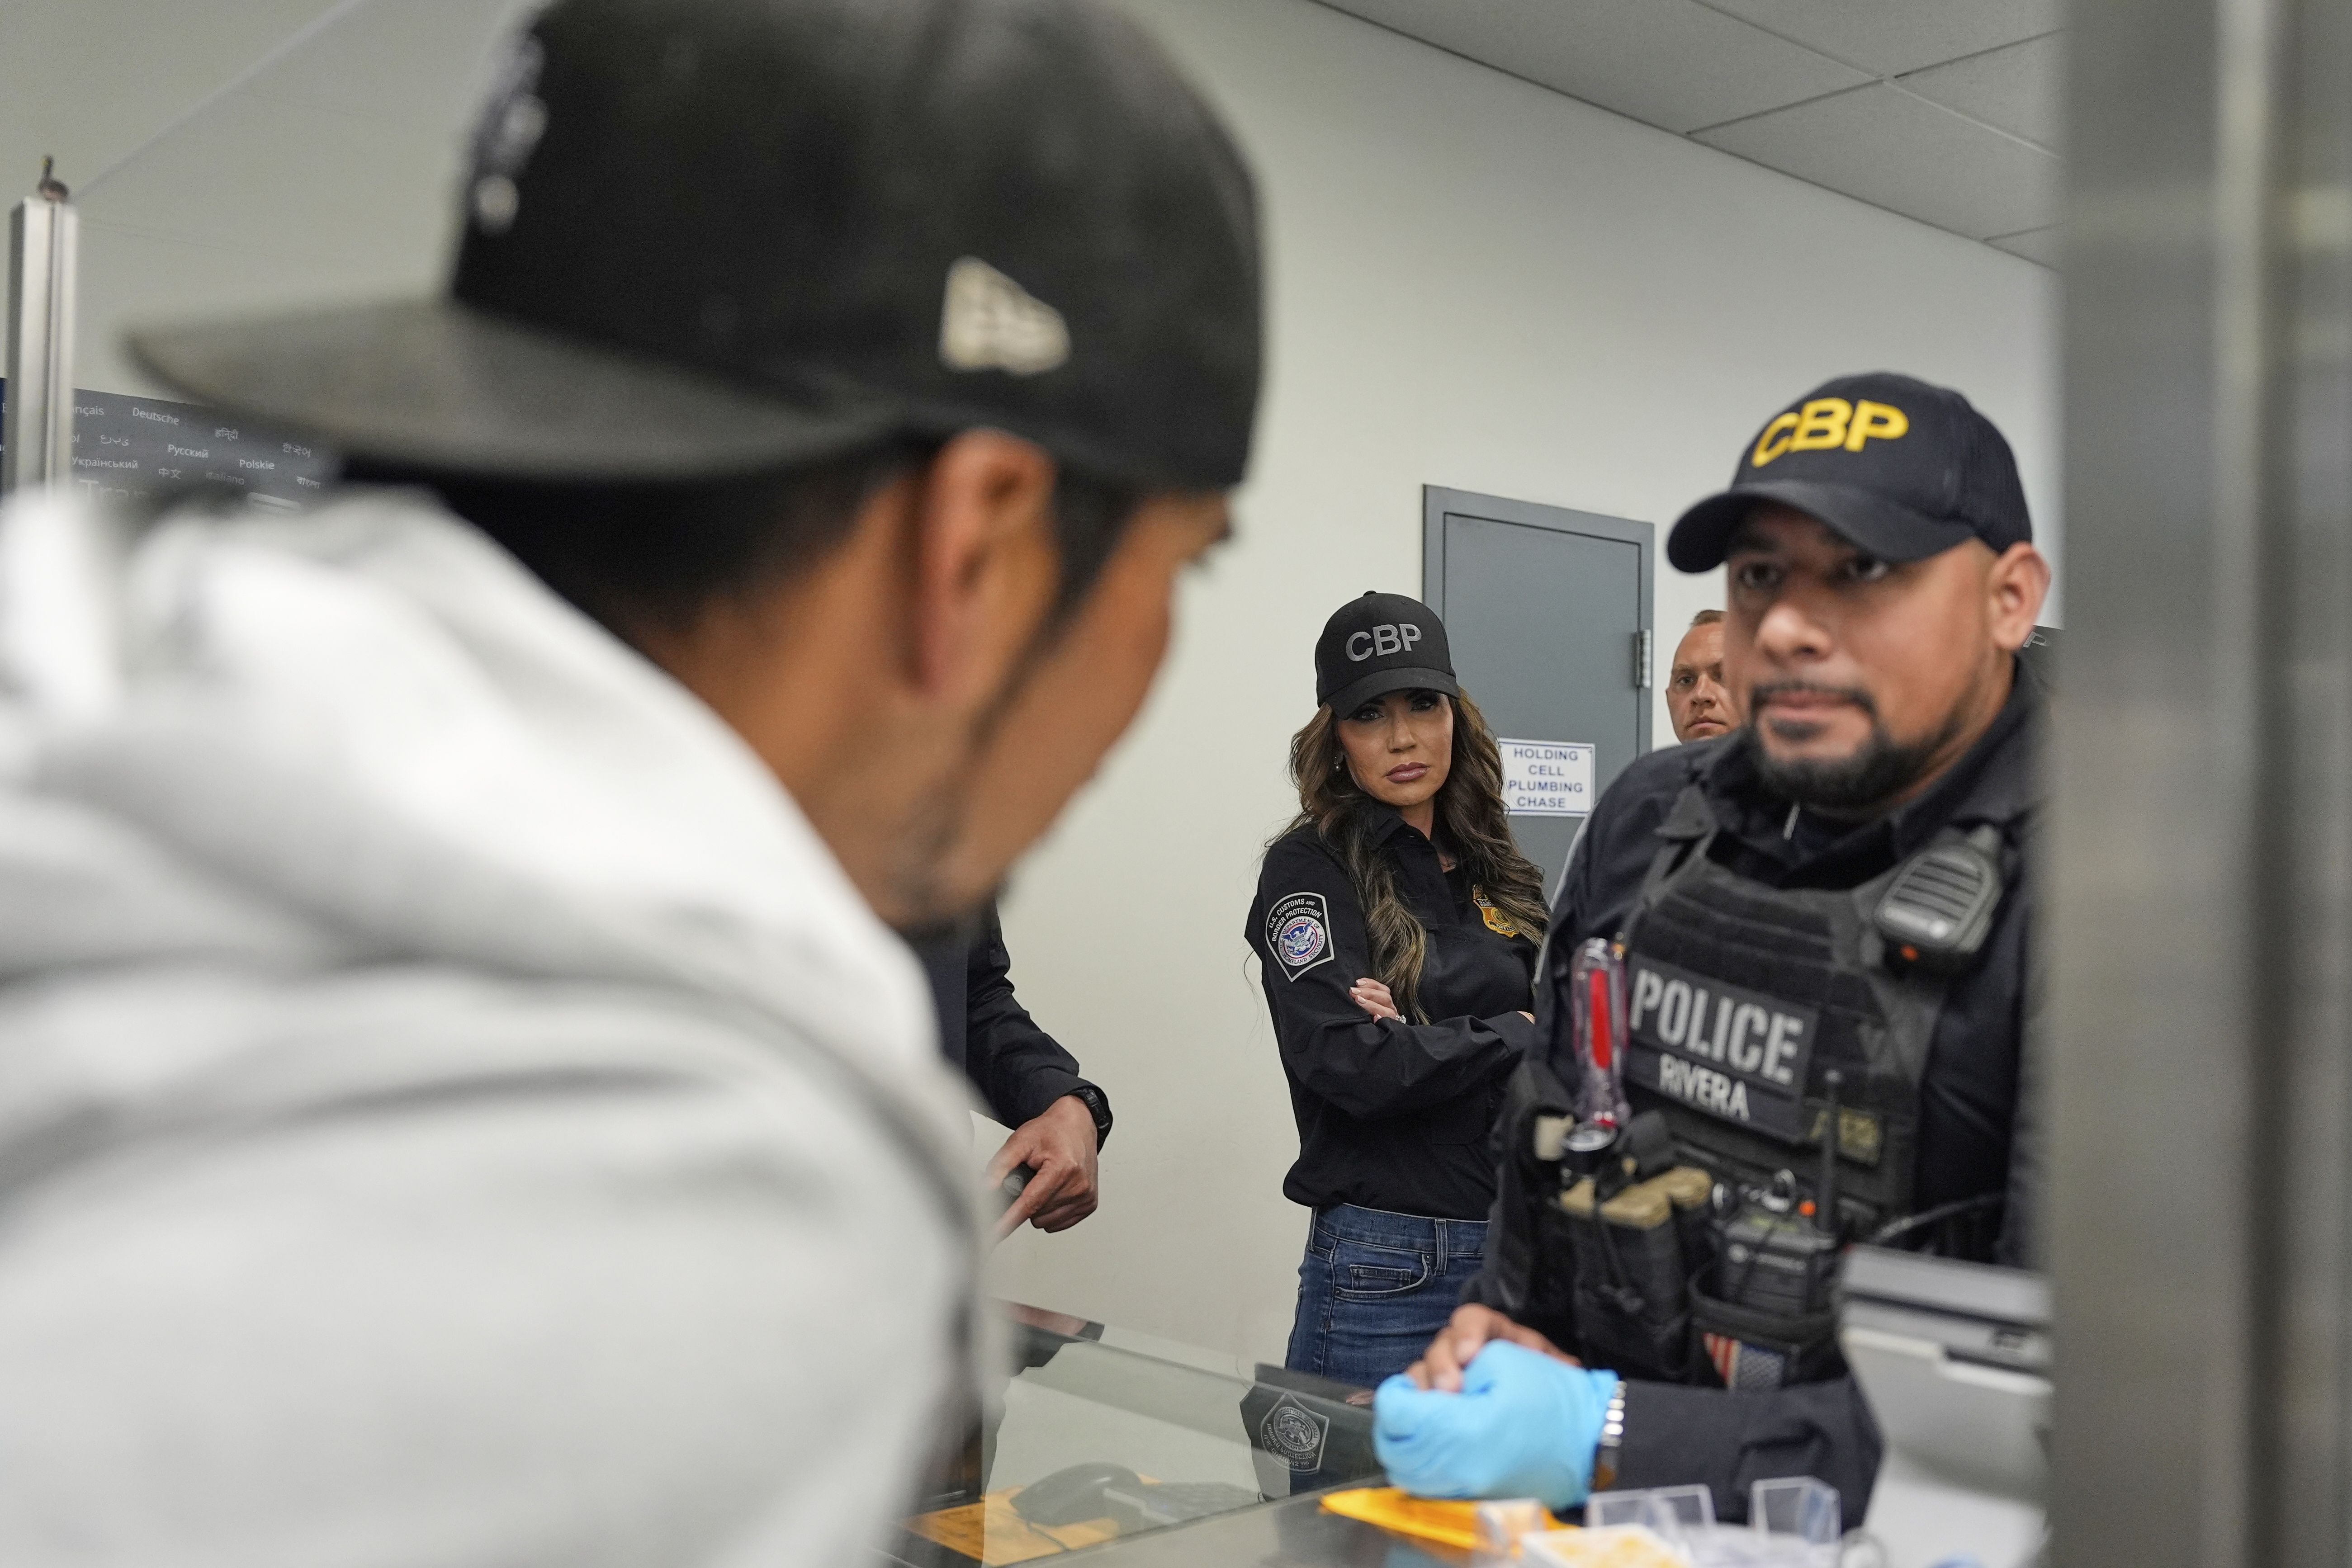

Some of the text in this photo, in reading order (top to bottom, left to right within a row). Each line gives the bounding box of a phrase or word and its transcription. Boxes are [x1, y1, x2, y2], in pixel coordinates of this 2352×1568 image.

[73, 406, 104, 417] nçais
[133, 407, 179, 425] Deutsche
[1751, 397, 1909, 468] CBP
[168, 444, 208, 458] Русский
[71, 456, 138, 469] Український
[239, 459, 274, 470] Polskie
[159, 467, 181, 479] 中文
[1346, 623, 1422, 661] CBP
[1514, 748, 1578, 760] HOLDING
[1529, 765, 1564, 776] CELL
[1509, 780, 1583, 792] PLUMBING
[1517, 796, 1566, 808] CHASE
[1269, 916, 1278, 928] U.S.
[1277, 898, 1305, 916] CUSTOMS
[1272, 907, 1322, 942] BORDER PROTECTION
[1282, 918, 1314, 934] DEPARTMENT
[1282, 934, 1323, 964] HOMELAND SECURITY
[1630, 968, 1805, 1085] POLICE
[1659, 1053, 1750, 1122] RIVERA
